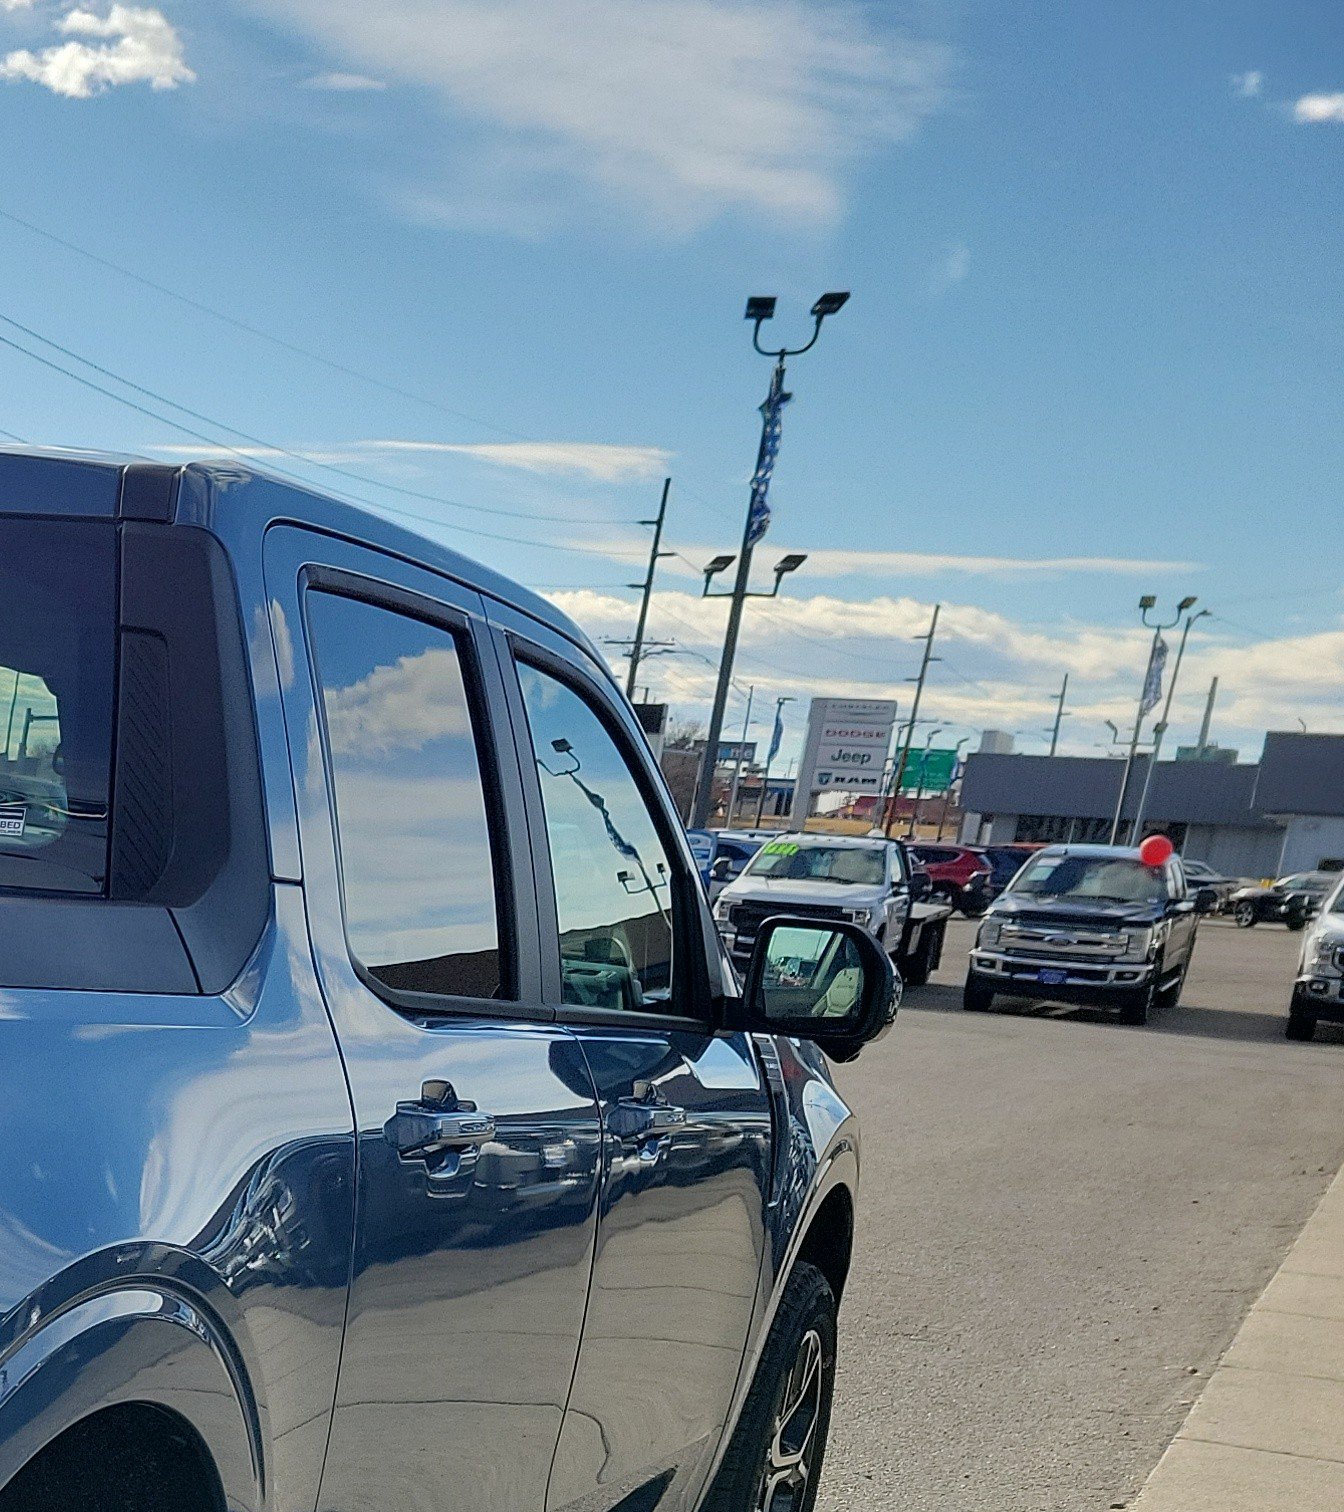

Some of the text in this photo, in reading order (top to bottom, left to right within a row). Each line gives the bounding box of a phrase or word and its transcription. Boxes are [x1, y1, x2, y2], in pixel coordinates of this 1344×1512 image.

[825, 729, 886, 739] DODGE
[831, 749, 872, 765] Jeep
[834, 776, 877, 785] RAM
